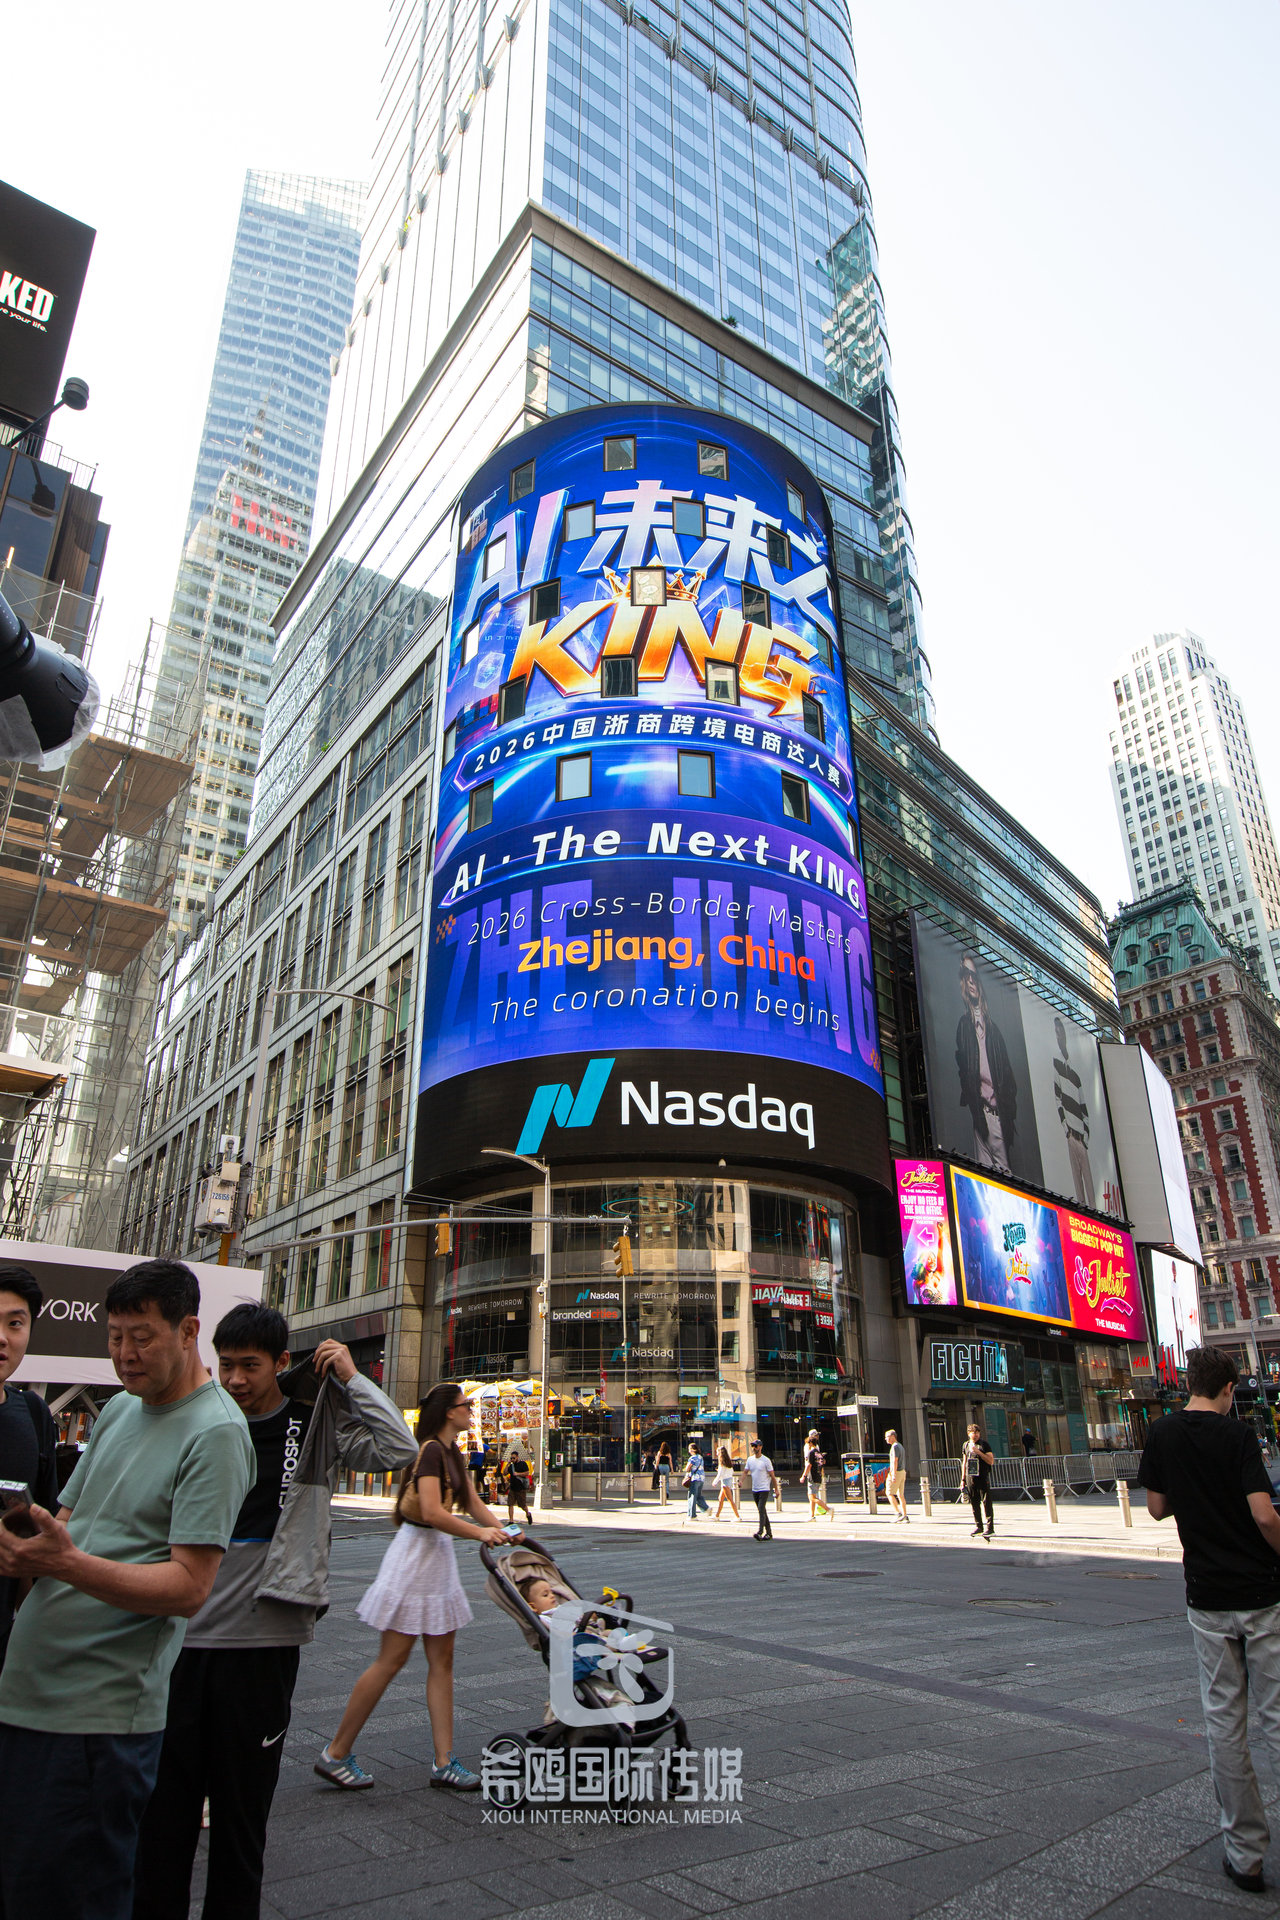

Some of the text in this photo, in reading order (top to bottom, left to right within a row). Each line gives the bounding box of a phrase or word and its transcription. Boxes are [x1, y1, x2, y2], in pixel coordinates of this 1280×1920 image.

[9, 311, 32, 325] your
[32, 320, 48, 333] life.
[507, 597, 824, 719] KING
[450, 854, 486, 900] AI
[532, 825, 621, 866] The
[647, 822, 770, 866] Next
[788, 844, 860, 909] KING
[468, 891, 853, 955] 2026 Cross-Border Masters
[517, 928, 817, 982] Zhejiang, China
[490, 983, 841, 1031] The coronation begins
[621, 1080, 816, 1150] Nasdaq
[1068, 1216, 1123, 1244] BROADWAY'S
[1070, 1228, 1100, 1250] BIGGEST
[37, 1298, 100, 1322] YORK
[590, 1291, 620, 1300] Nasdaq
[631, 1346, 674, 1360] Nasdaq
